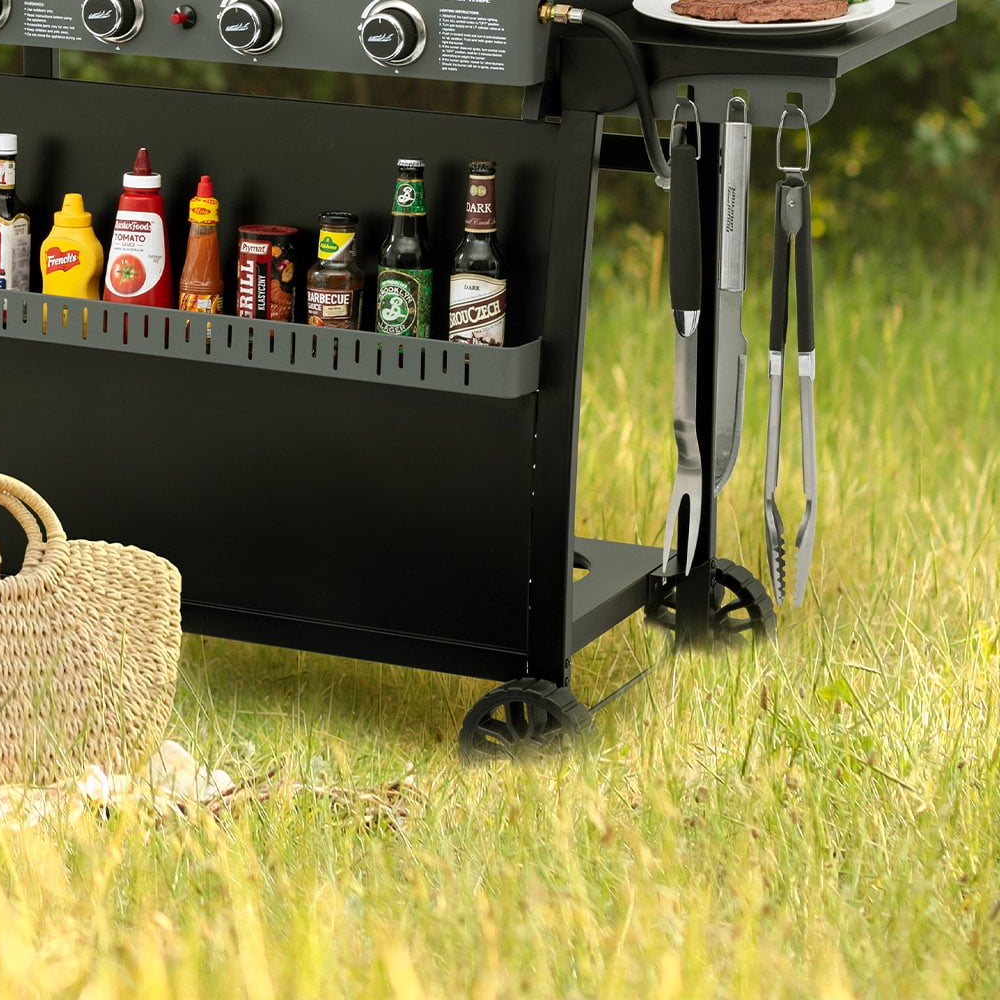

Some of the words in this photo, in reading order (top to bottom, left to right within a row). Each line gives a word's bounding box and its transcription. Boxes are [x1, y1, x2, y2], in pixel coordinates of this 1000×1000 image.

[466, 201, 492, 214] DARK
[114, 233, 146, 243] TOMATO
[47, 252, 77, 268] French's
[239, 259, 255, 319] GRILL
[257, 275, 267, 312] KLASYCZNY
[307, 291, 350, 305] BARBECUE
